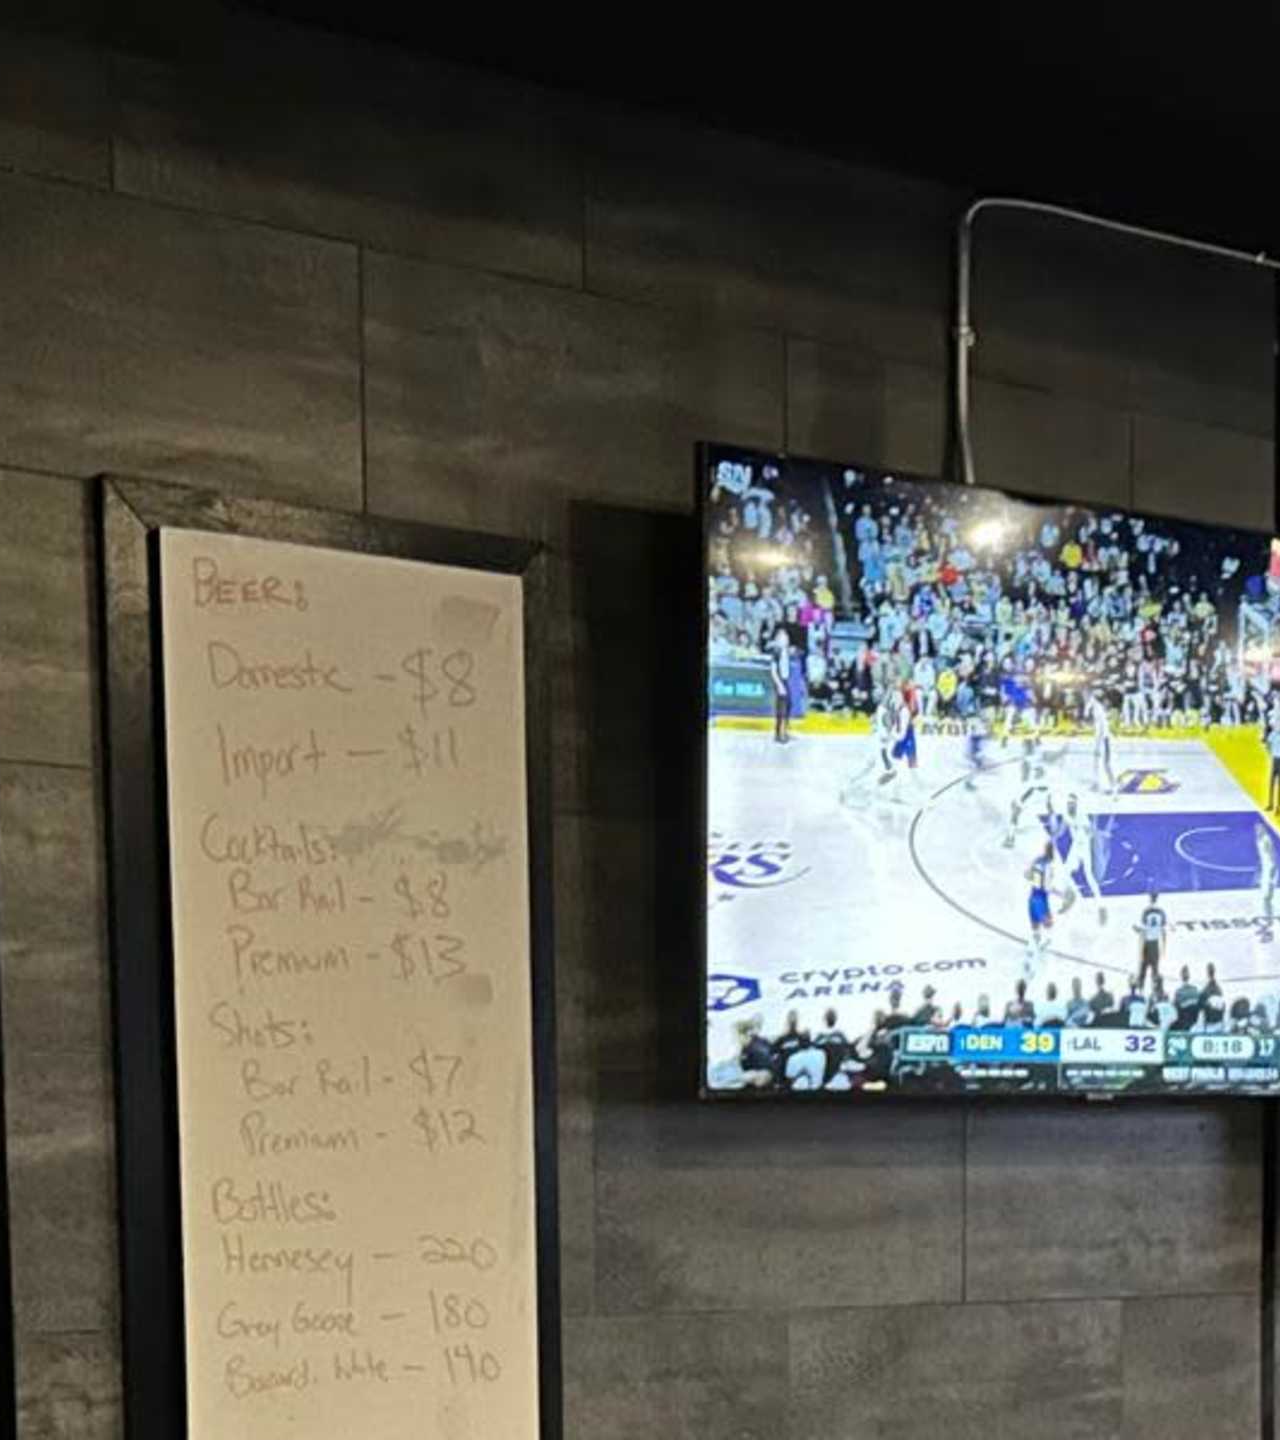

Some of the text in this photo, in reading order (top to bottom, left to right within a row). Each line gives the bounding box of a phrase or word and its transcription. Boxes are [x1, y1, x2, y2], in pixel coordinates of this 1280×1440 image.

[402, 648, 477, 717] $8
[217, 723, 326, 793] Import
[398, 723, 459, 778] $11
[229, 867, 287, 914] Bar
[394, 870, 451, 919] $8
[391, 932, 466, 983] $13
[779, 957, 987, 984] crypto.com
[785, 979, 904, 1001] ARENA
[966, 1034, 1003, 1051] DEN
[1073, 1036, 1102, 1051] LAL
[1124, 1036, 1156, 1053] 32
[242, 1058, 299, 1101] Bar
[316, 1056, 370, 1097] Rail
[408, 1047, 463, 1097] $7
[412, 1105, 487, 1152] $12
[419, 1235, 497, 1270] 220
[429, 1289, 490, 1335] 180
[444, 1344, 501, 1383] 140
